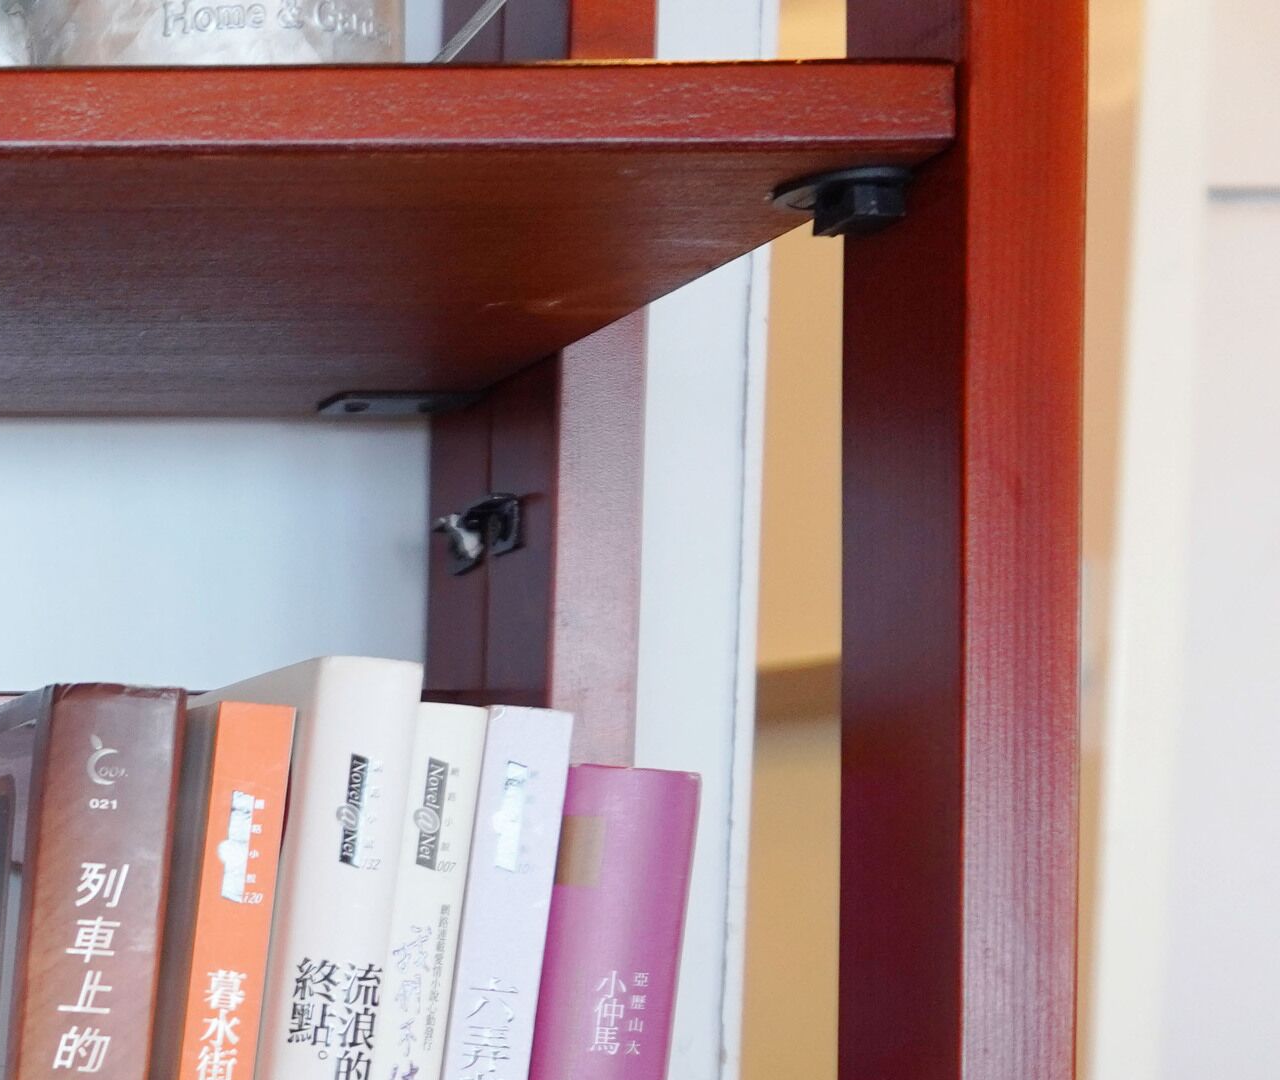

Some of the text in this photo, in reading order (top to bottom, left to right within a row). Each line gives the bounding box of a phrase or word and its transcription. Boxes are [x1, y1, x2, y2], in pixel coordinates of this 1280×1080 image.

[89, 798, 118, 811] 021
[589, 969, 627, 1055] 小仲馬
[624, 971, 650, 1056] 亞歷山大
